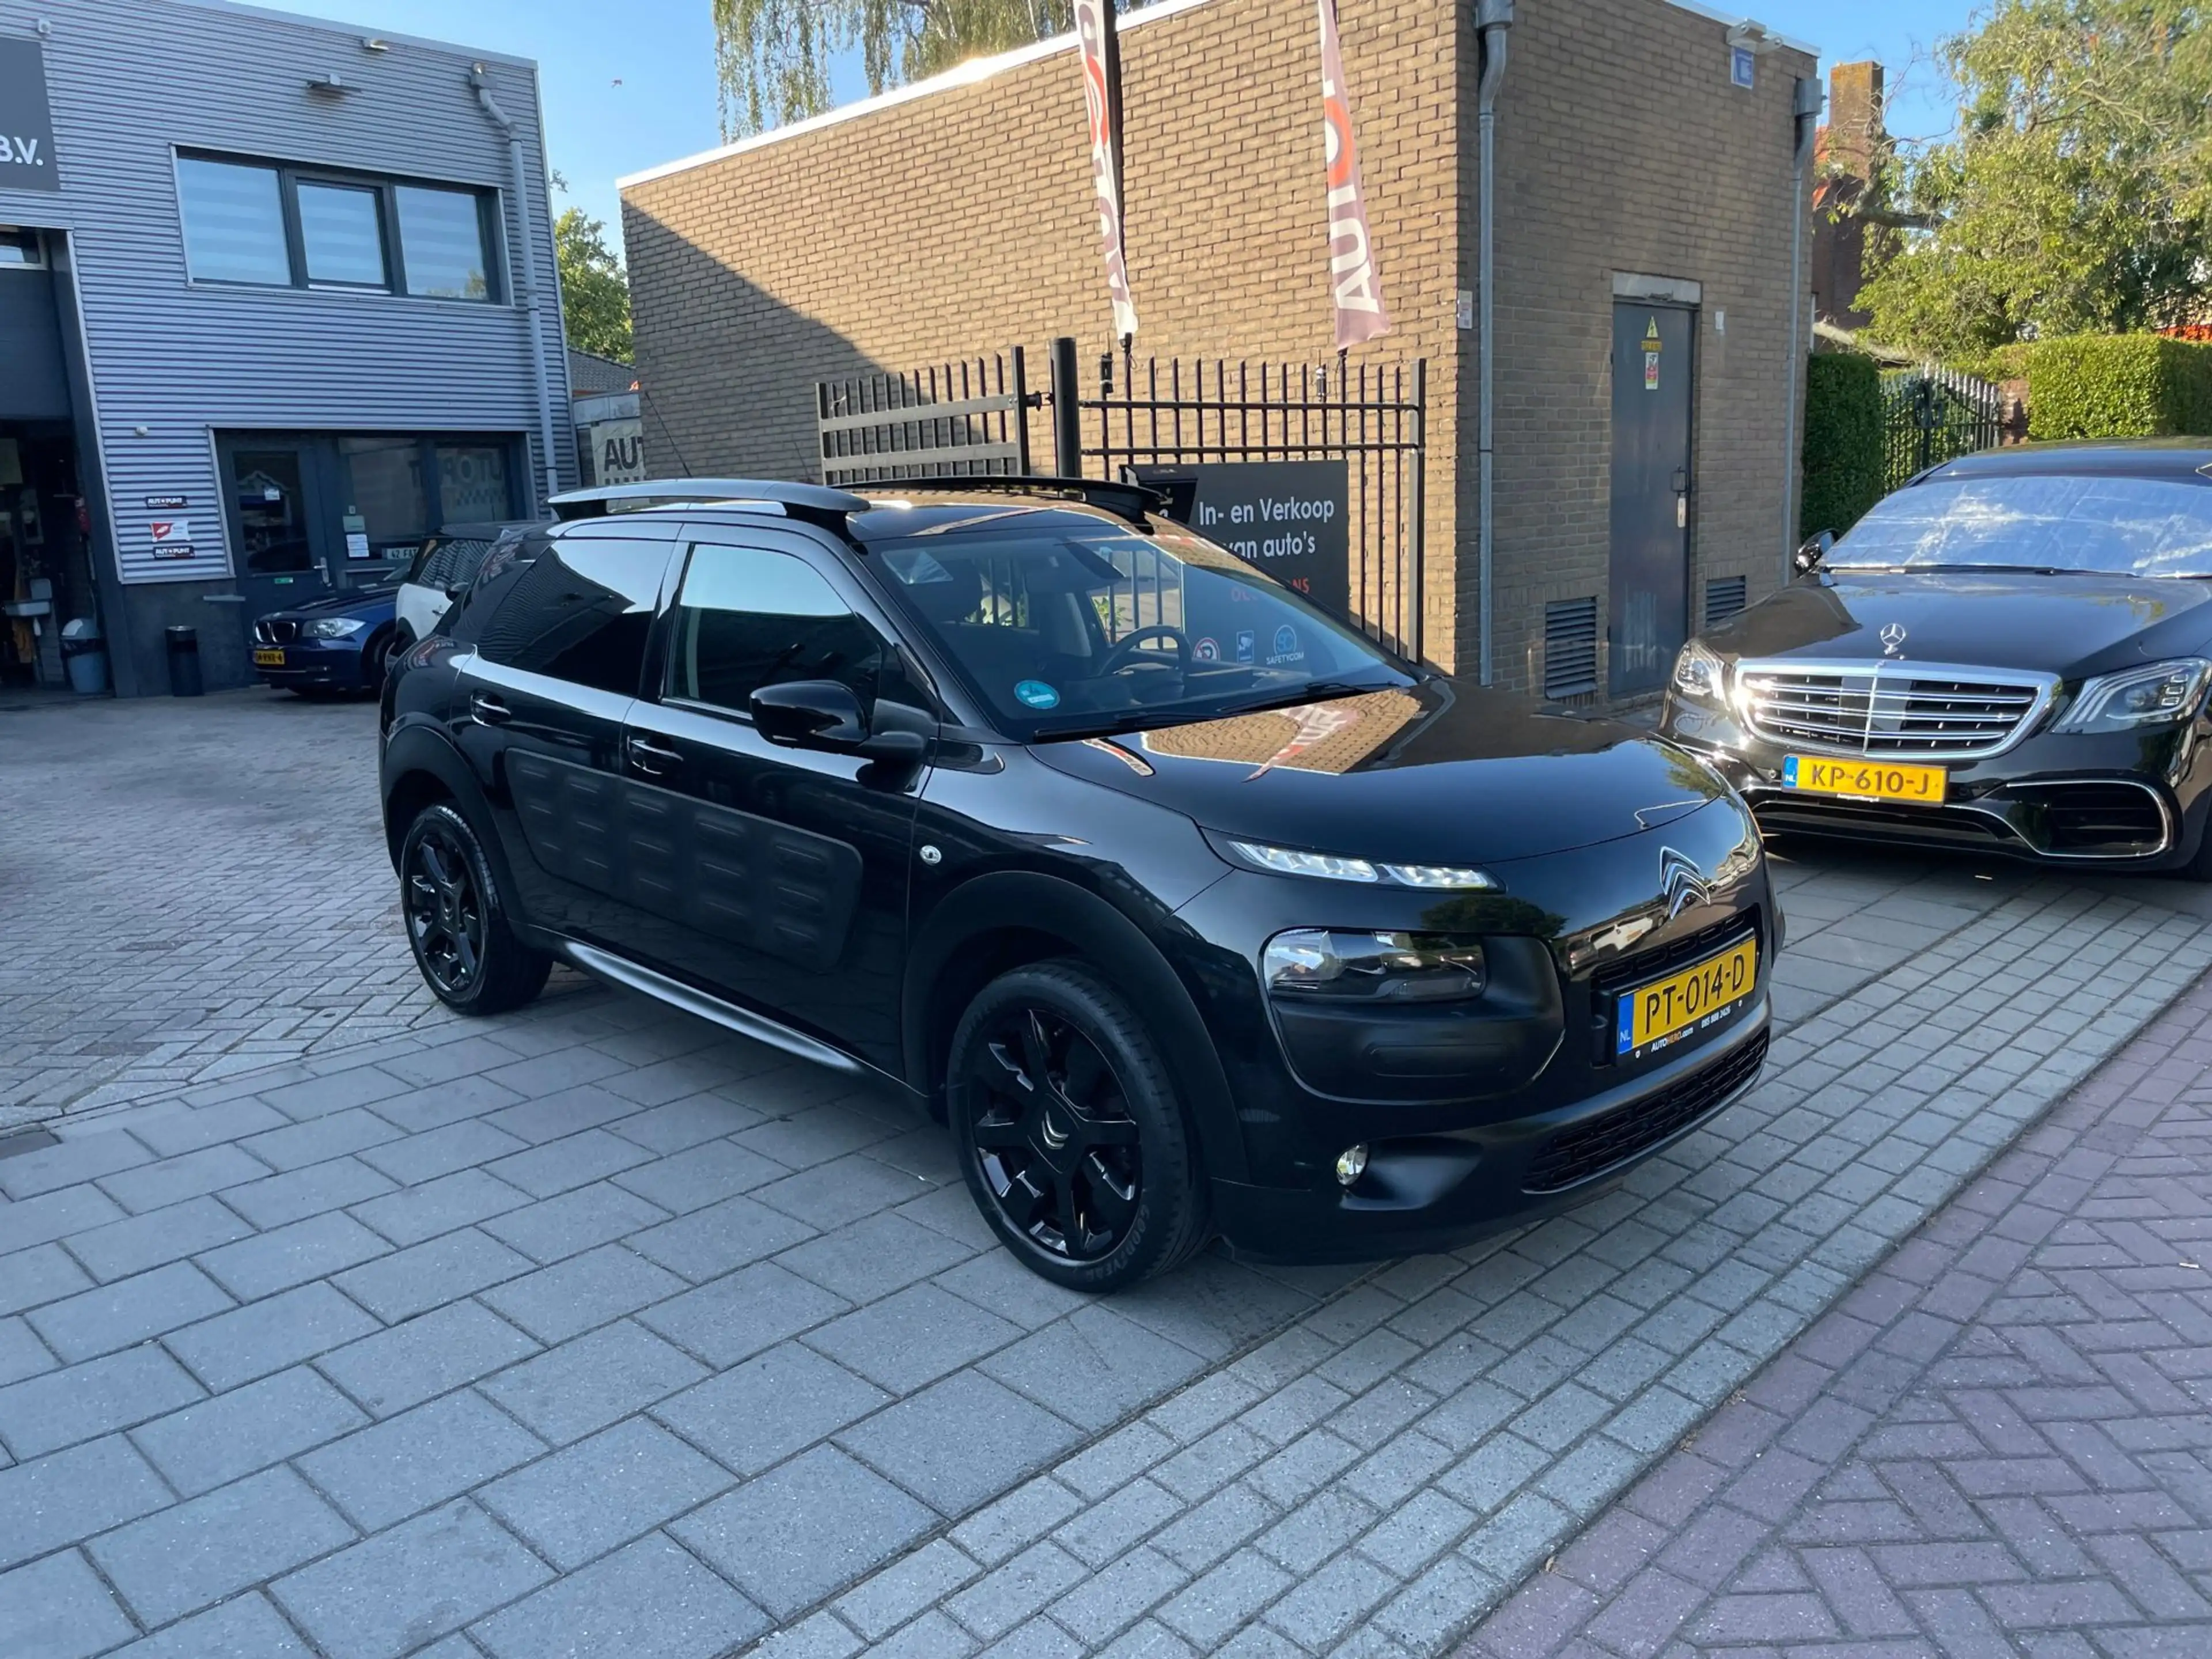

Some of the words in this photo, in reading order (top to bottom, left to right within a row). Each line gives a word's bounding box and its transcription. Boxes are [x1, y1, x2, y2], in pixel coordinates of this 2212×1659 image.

[0, 135, 44, 166] B.V.
[1199, 501, 1224, 525] In-
[1230, 504, 1254, 524] en
[1259, 496, 1335, 523] Verkoop
[1263, 531, 1316, 558] auto's
[1785, 773, 1796, 782] NL
[1811, 763, 1929, 795] KP-610-J
[1645, 953, 1745, 1035] PT-014-D
[1619, 1028, 1631, 1044] NL
